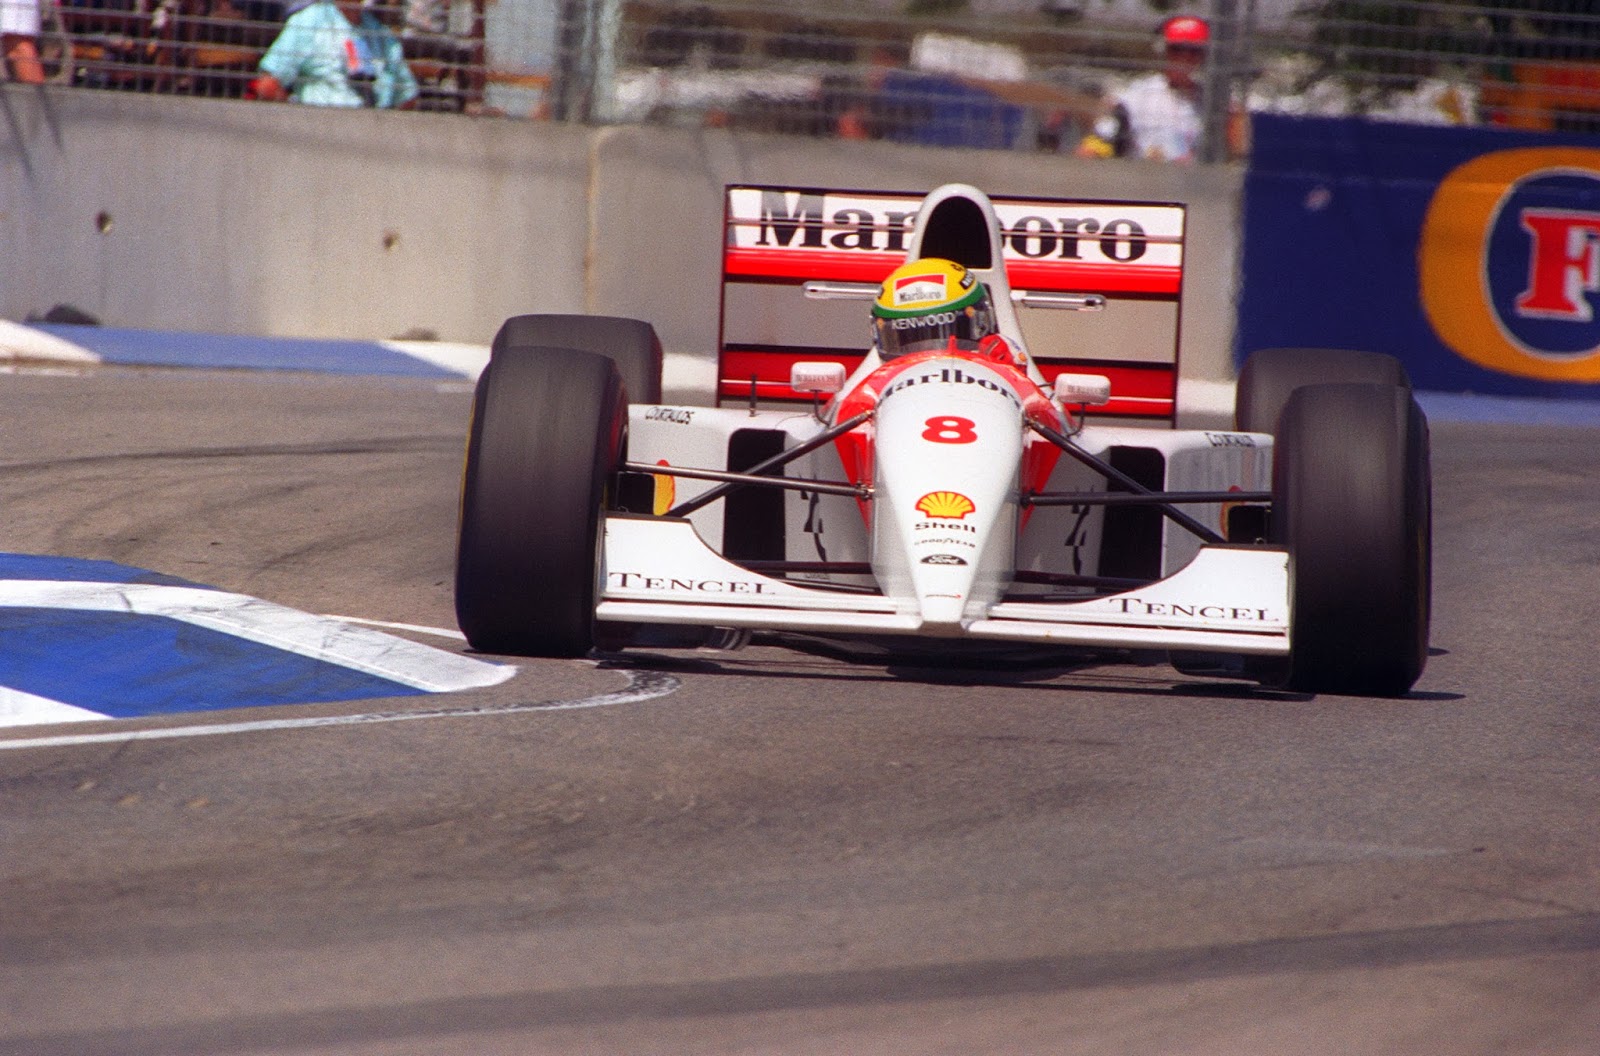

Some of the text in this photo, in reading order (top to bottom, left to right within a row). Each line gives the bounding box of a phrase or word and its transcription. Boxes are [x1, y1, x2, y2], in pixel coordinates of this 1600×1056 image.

[755, 190, 1146, 263] Maroro
[891, 311, 957, 330] KENWOOD
[921, 415, 978, 445] 8
[914, 521, 976, 534] Shell
